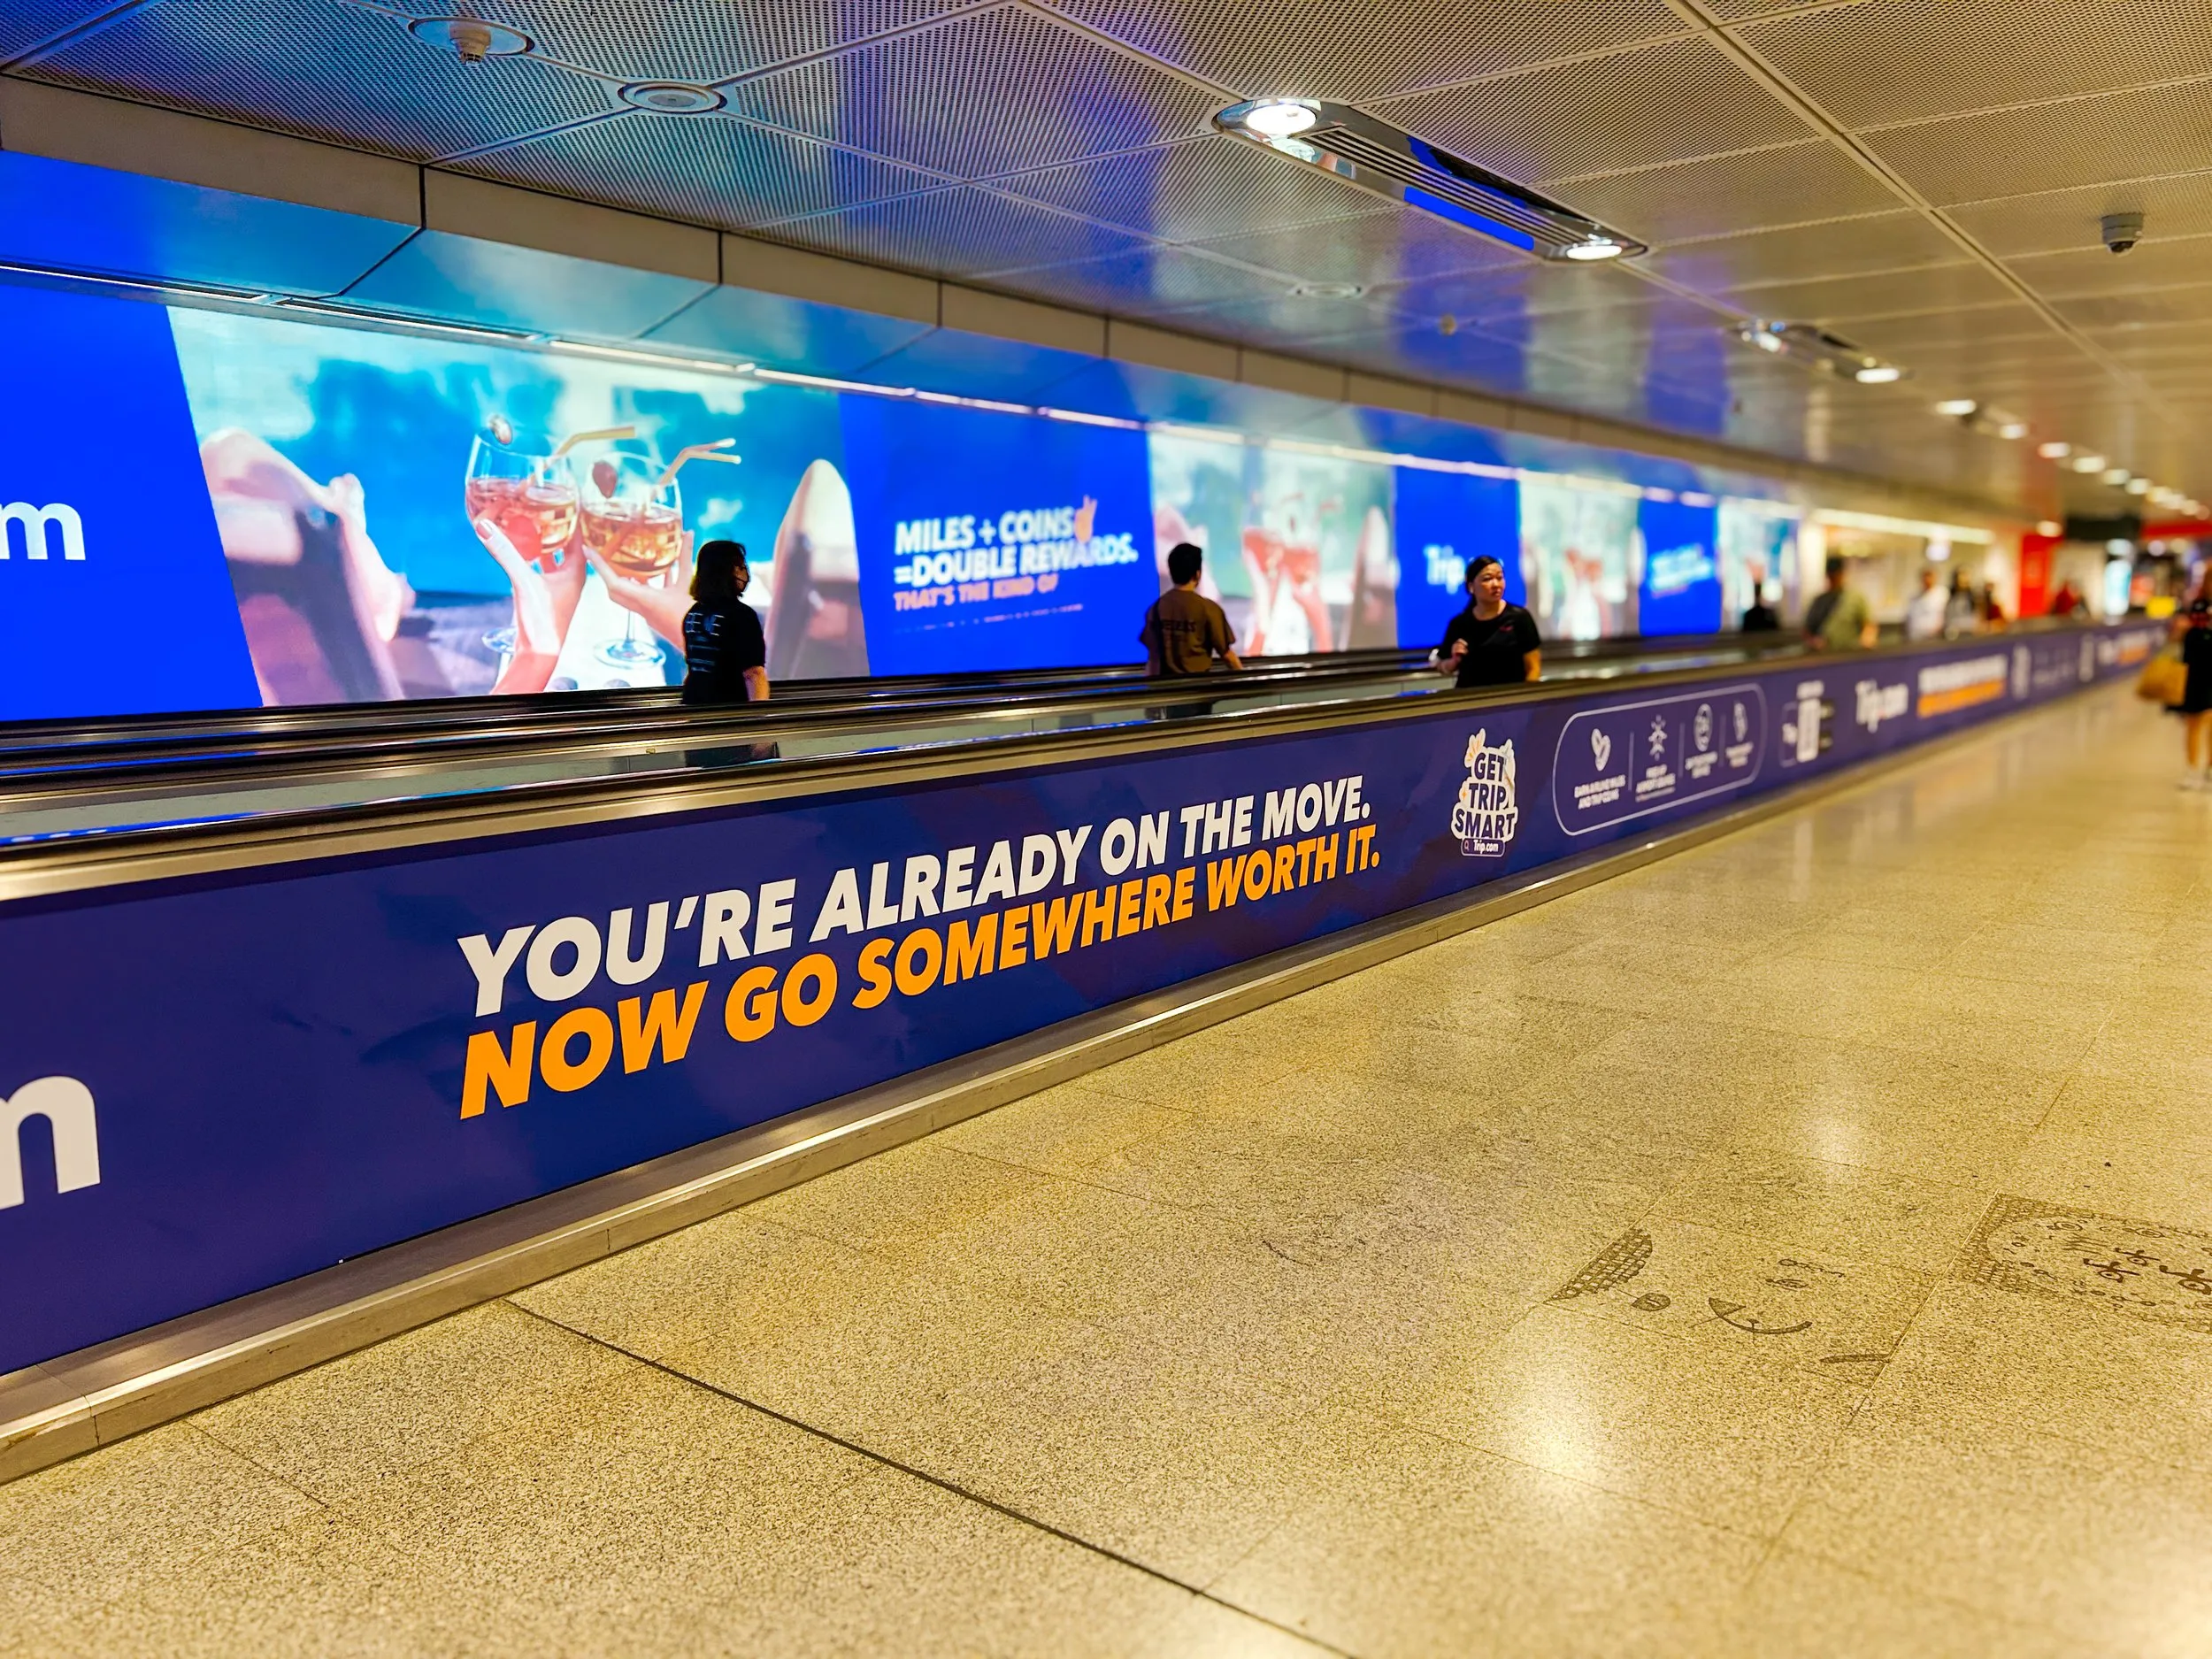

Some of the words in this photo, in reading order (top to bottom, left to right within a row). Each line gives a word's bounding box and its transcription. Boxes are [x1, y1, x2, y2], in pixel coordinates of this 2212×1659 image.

[895, 515, 976, 555] MILES
[998, 505, 1075, 546] COINS
[894, 586, 955, 611] THAT'S
[1474, 752, 1505, 782] GET
[1469, 782, 1507, 811] TRIP
[1455, 808, 1516, 840] SMART
[1473, 839, 1499, 855] Trip.com
[457, 878, 796, 1018] YOU'RE
[809, 825, 1094, 943] ALREADY
[1100, 810, 1171, 876] ON
[1179, 795, 1255, 858] THE
[1261, 775, 1371, 841] MOVE.
[460, 980, 709, 1120] NOW
[725, 952, 839, 1042] GO
[852, 866, 1196, 1010] SOMEWHERE
[1207, 833, 1340, 911] WORTH
[1346, 825, 1380, 874] IT.
